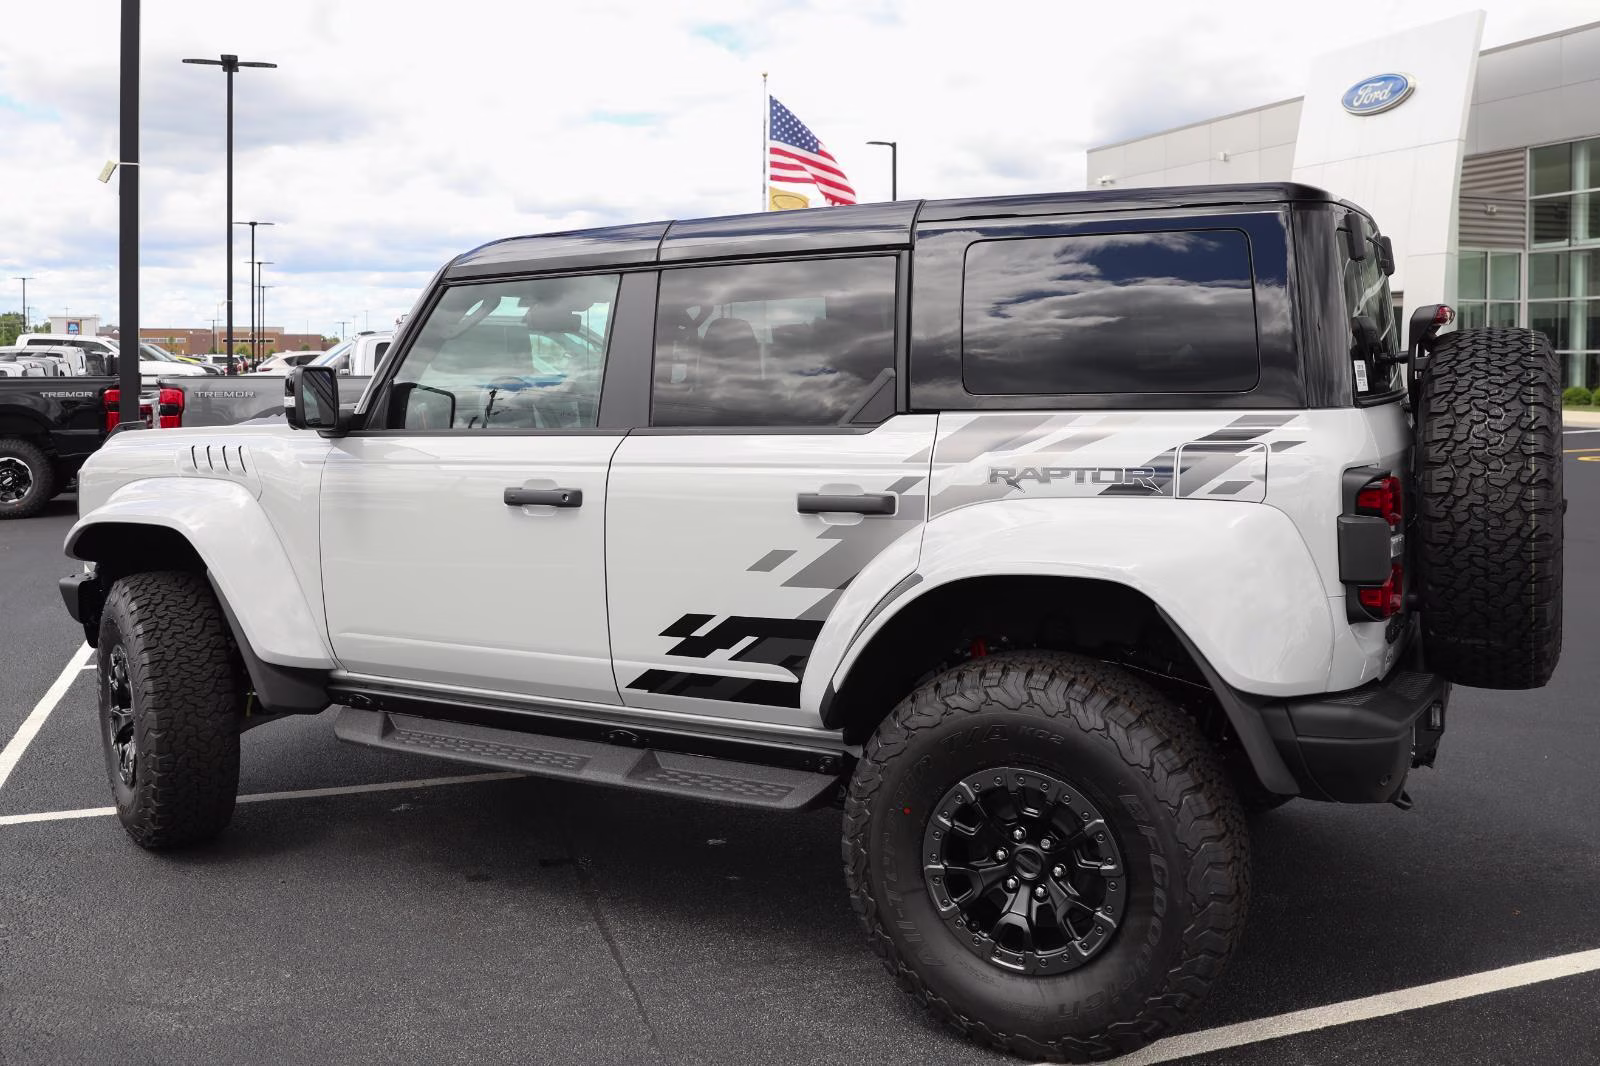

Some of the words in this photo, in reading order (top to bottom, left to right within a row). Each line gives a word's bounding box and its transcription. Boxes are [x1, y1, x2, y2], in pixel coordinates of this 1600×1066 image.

[1352, 80, 1394, 107] Ford
[39, 390, 94, 398] TREMOR
[194, 390, 256, 399] TREMOR
[987, 466, 1163, 494] RAPTOR
